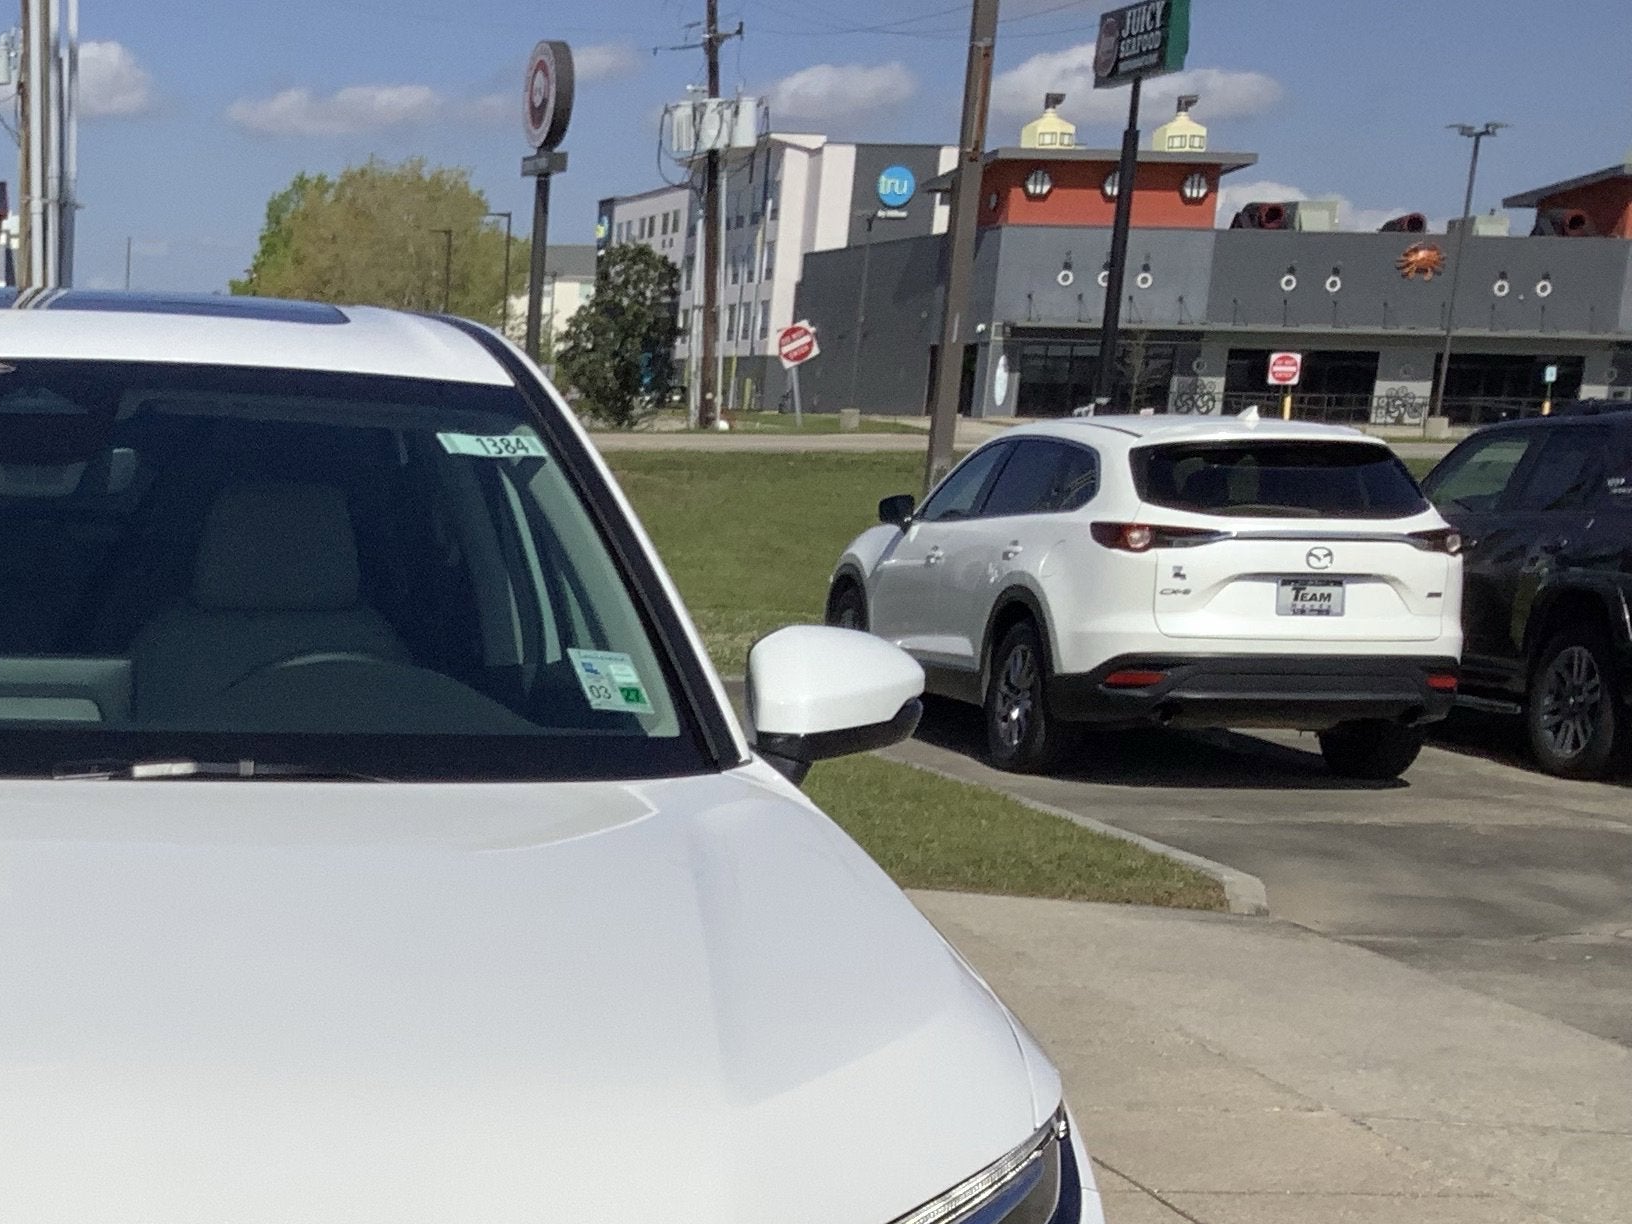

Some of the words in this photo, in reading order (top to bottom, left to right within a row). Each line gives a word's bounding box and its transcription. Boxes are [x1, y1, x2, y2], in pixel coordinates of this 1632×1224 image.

[1121, 0, 1166, 38] JUICY
[1119, 30, 1161, 58] SEAFOOD
[879, 175, 908, 195] tru
[476, 437, 529, 455] 1384
[589, 685, 612, 700] 03
